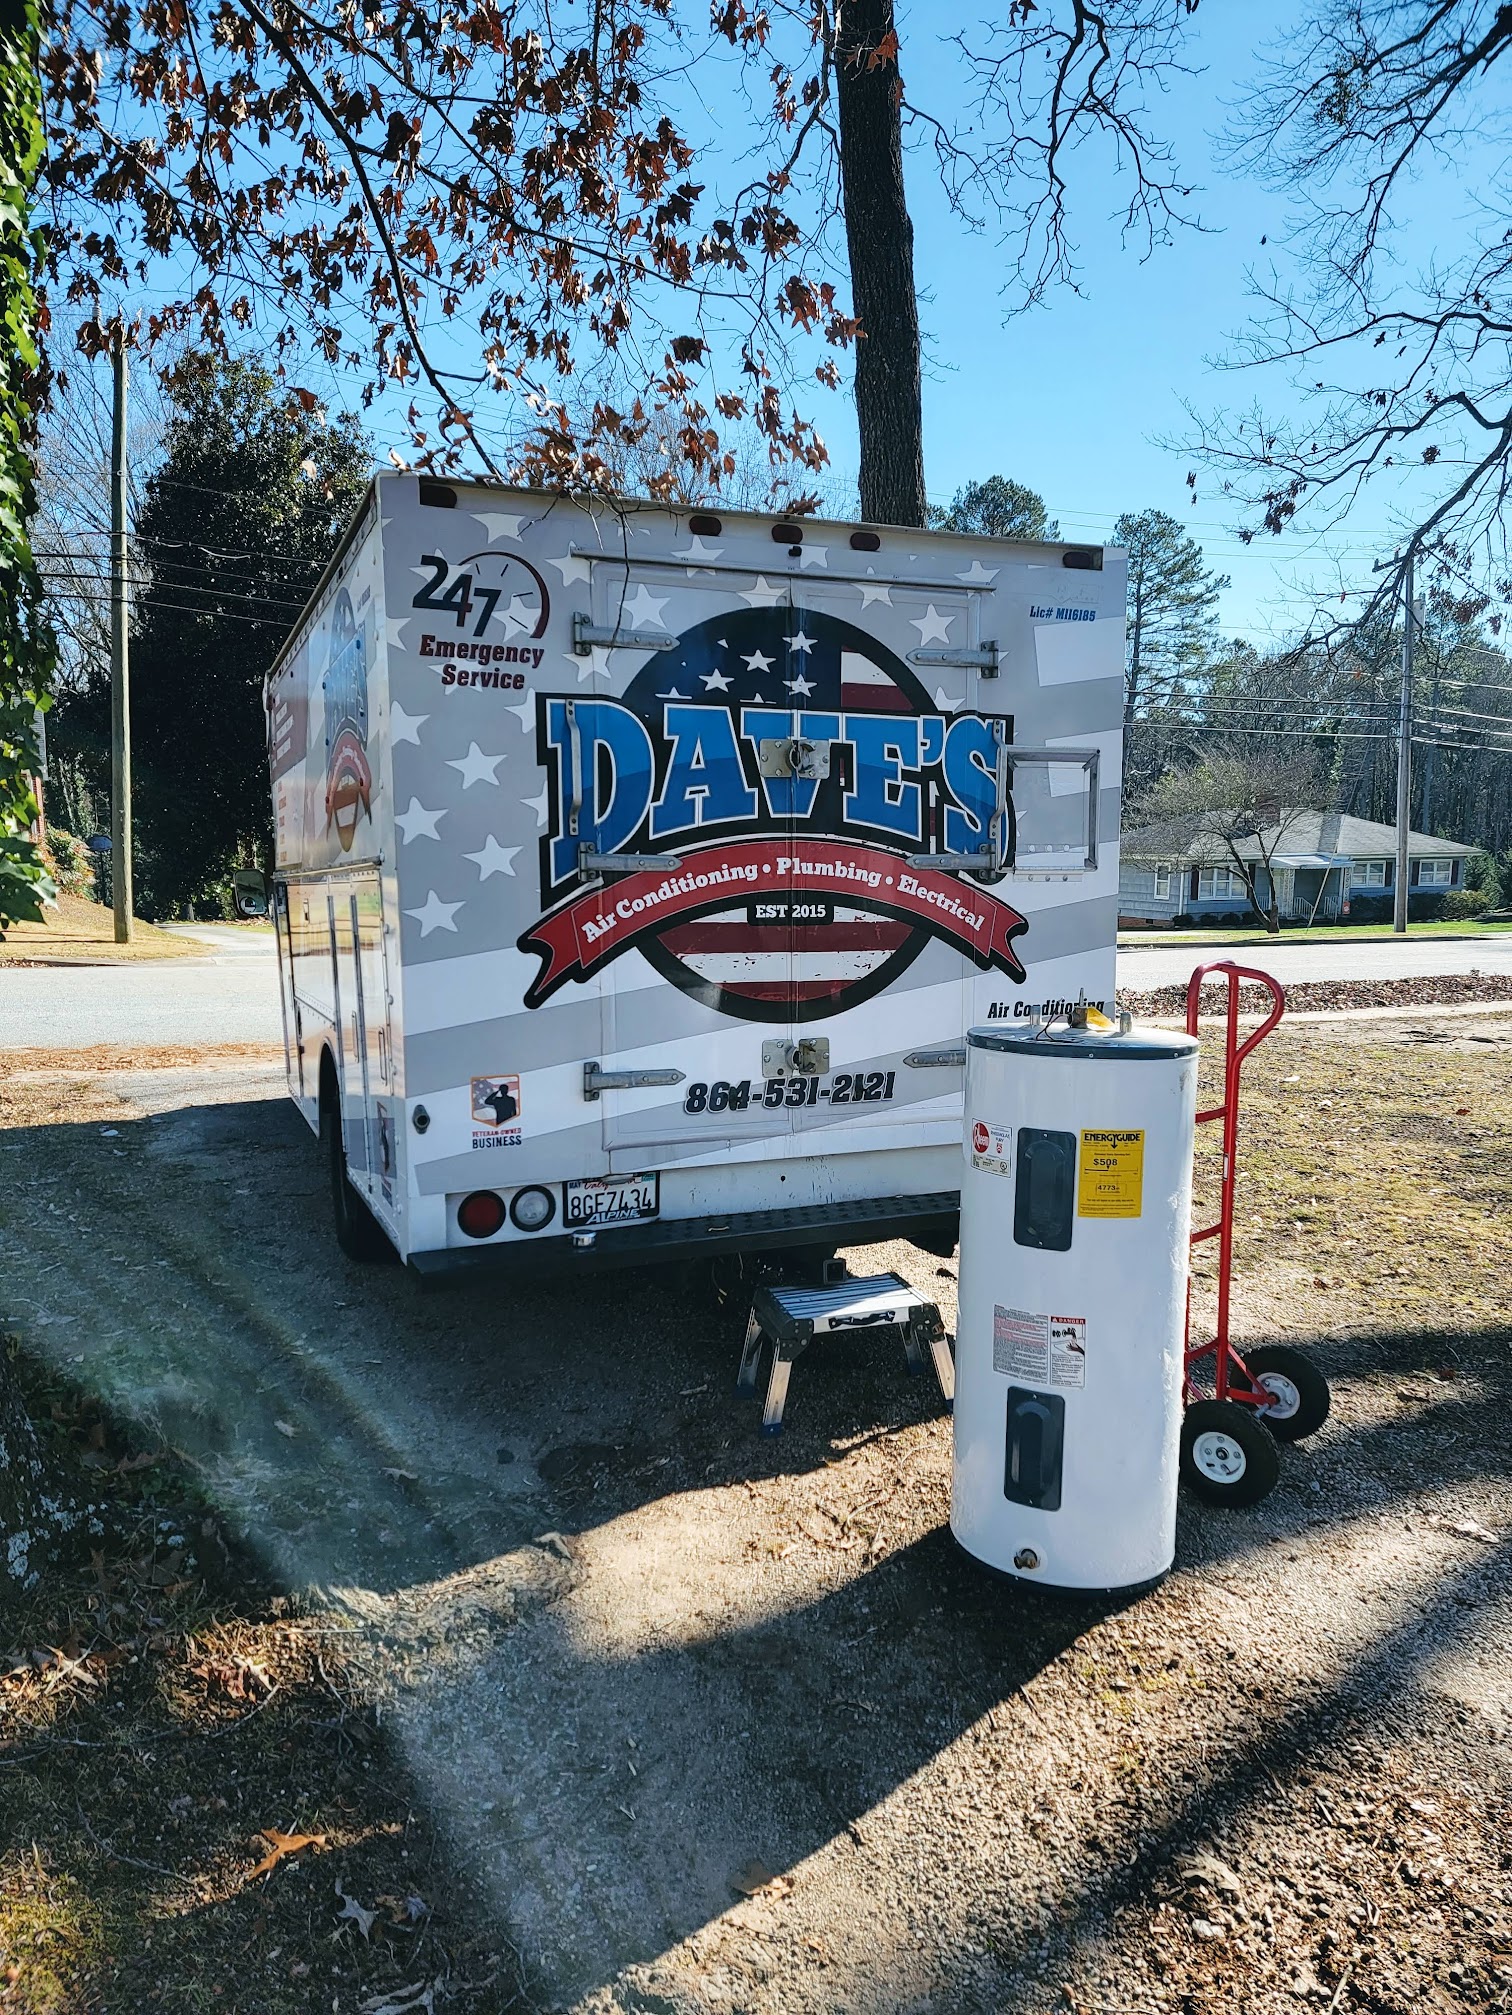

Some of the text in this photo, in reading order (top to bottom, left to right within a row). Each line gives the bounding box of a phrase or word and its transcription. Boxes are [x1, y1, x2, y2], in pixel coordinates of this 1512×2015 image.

[1029, 606, 1053, 619] Lic#
[419, 634, 544, 668] Emergency
[441, 664, 525, 690] Service
[546, 699, 1010, 888] DAVE'S
[581, 857, 986, 943] Air Conditioning Plumbing Electrical
[755, 904, 827, 919] EST 2015
[987, 1002, 1010, 1018] Air
[684, 1071, 897, 1115] 864-531-2121
[472, 1135, 522, 1149] BUSINESS
[585, 1208, 641, 1225] ALPINE
